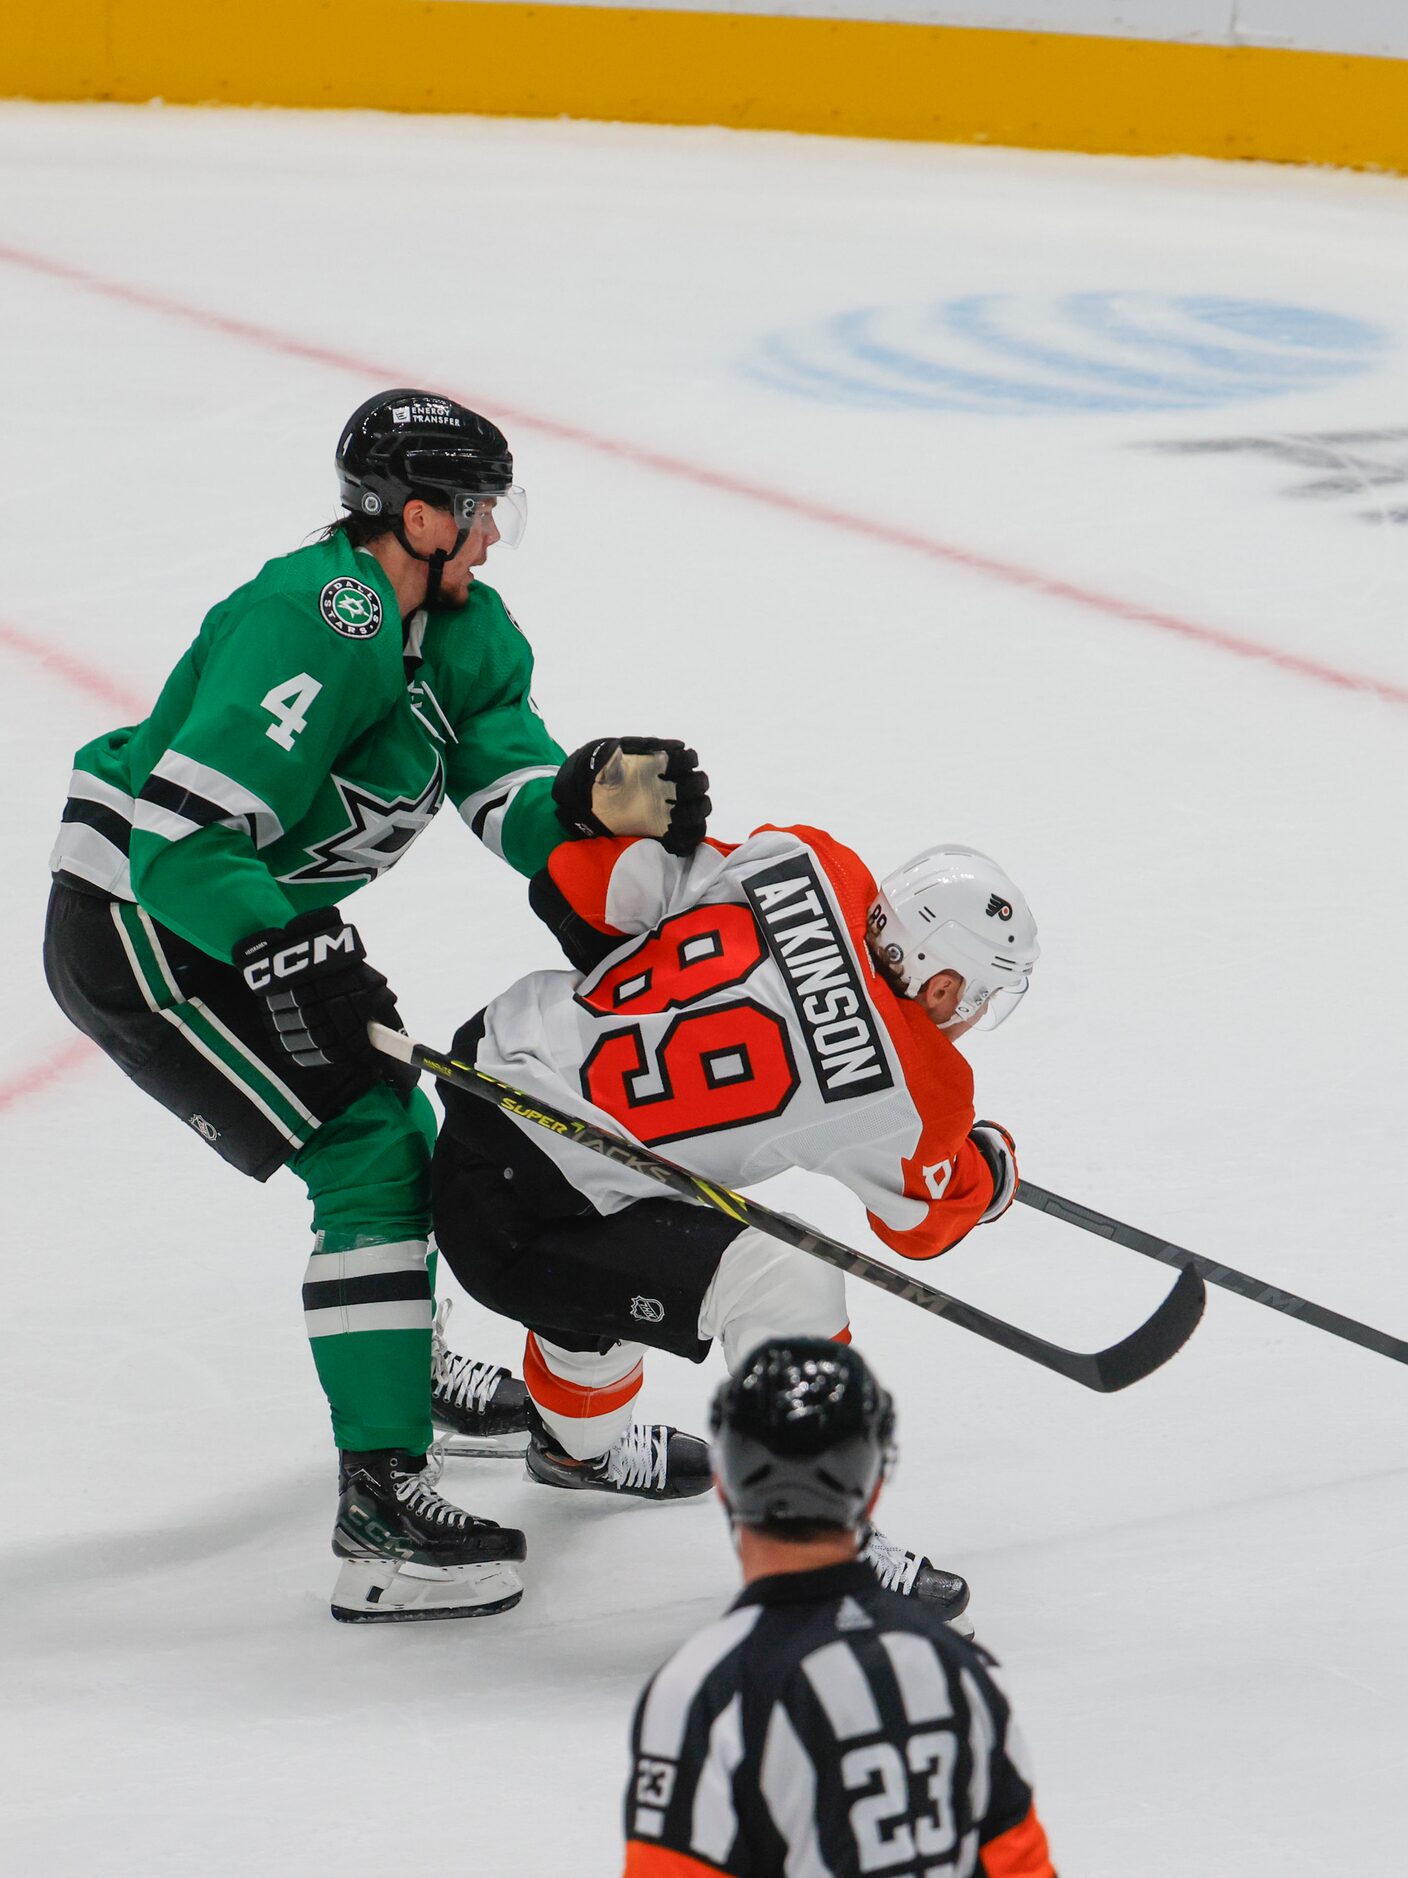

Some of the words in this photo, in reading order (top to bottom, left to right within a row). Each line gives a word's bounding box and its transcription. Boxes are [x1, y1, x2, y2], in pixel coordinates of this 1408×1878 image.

[411, 406, 452, 417] ENERGY
[411, 414, 461, 427] TRANSFER
[323, 599, 368, 635] STARS
[332, 580, 380, 624] DALLAS
[259, 671, 323, 752] 4
[243, 926, 355, 991] CCM
[753, 875, 883, 1089] ATKINSON
[573, 901, 802, 1149] 89
[841, 1729, 959, 1873] 23
